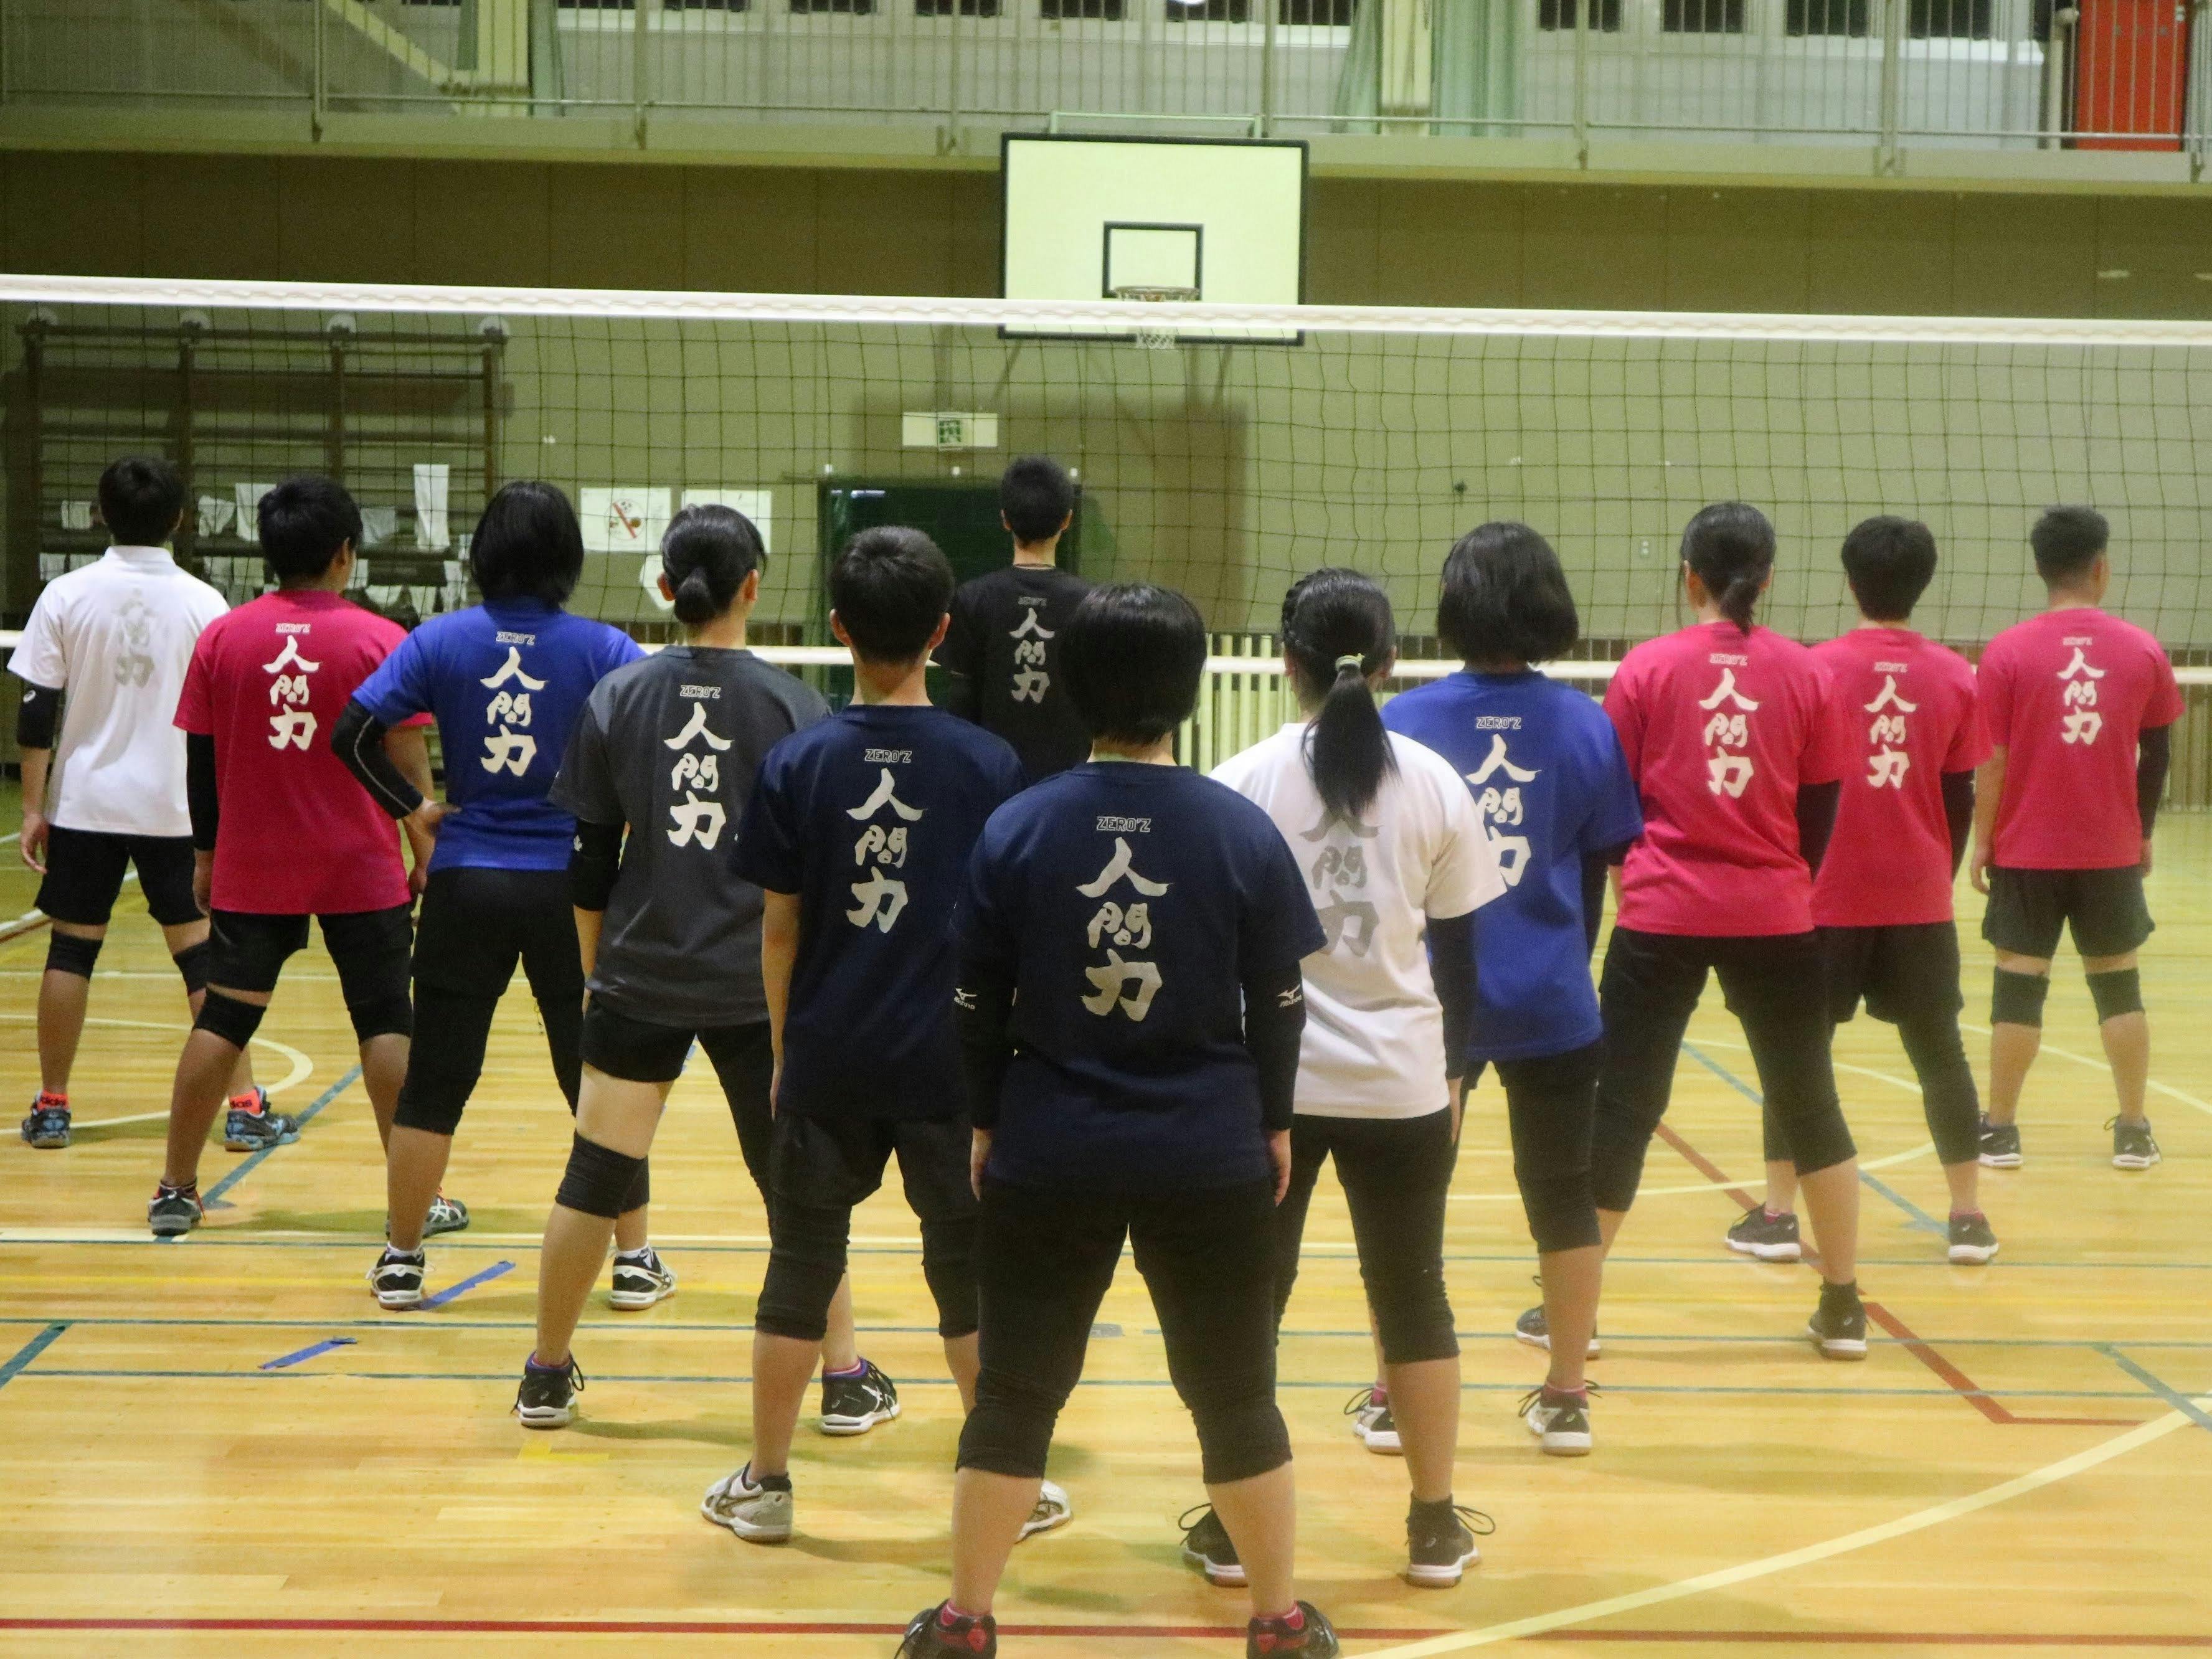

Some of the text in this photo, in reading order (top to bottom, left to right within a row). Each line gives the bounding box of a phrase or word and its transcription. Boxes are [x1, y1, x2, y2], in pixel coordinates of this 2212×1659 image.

[262, 635, 321, 750] 人間力
[480, 646, 549, 777] 人間力
[680, 685, 721, 699] ZERO'Z
[1009, 608, 1055, 703] 人間力
[2057, 647, 2106, 745] 人間力
[664, 702, 734, 850] 人間力
[864, 749, 912, 763] ZERO'Z
[1477, 716, 1521, 729] ZERO'Z
[1698, 668, 1759, 798] 人間力
[1864, 674, 1917, 789] 人間力
[846, 768, 928, 933] 人間力
[1097, 816, 1151, 833] ZERO'Z
[1075, 837, 1175, 1022] 人間力
